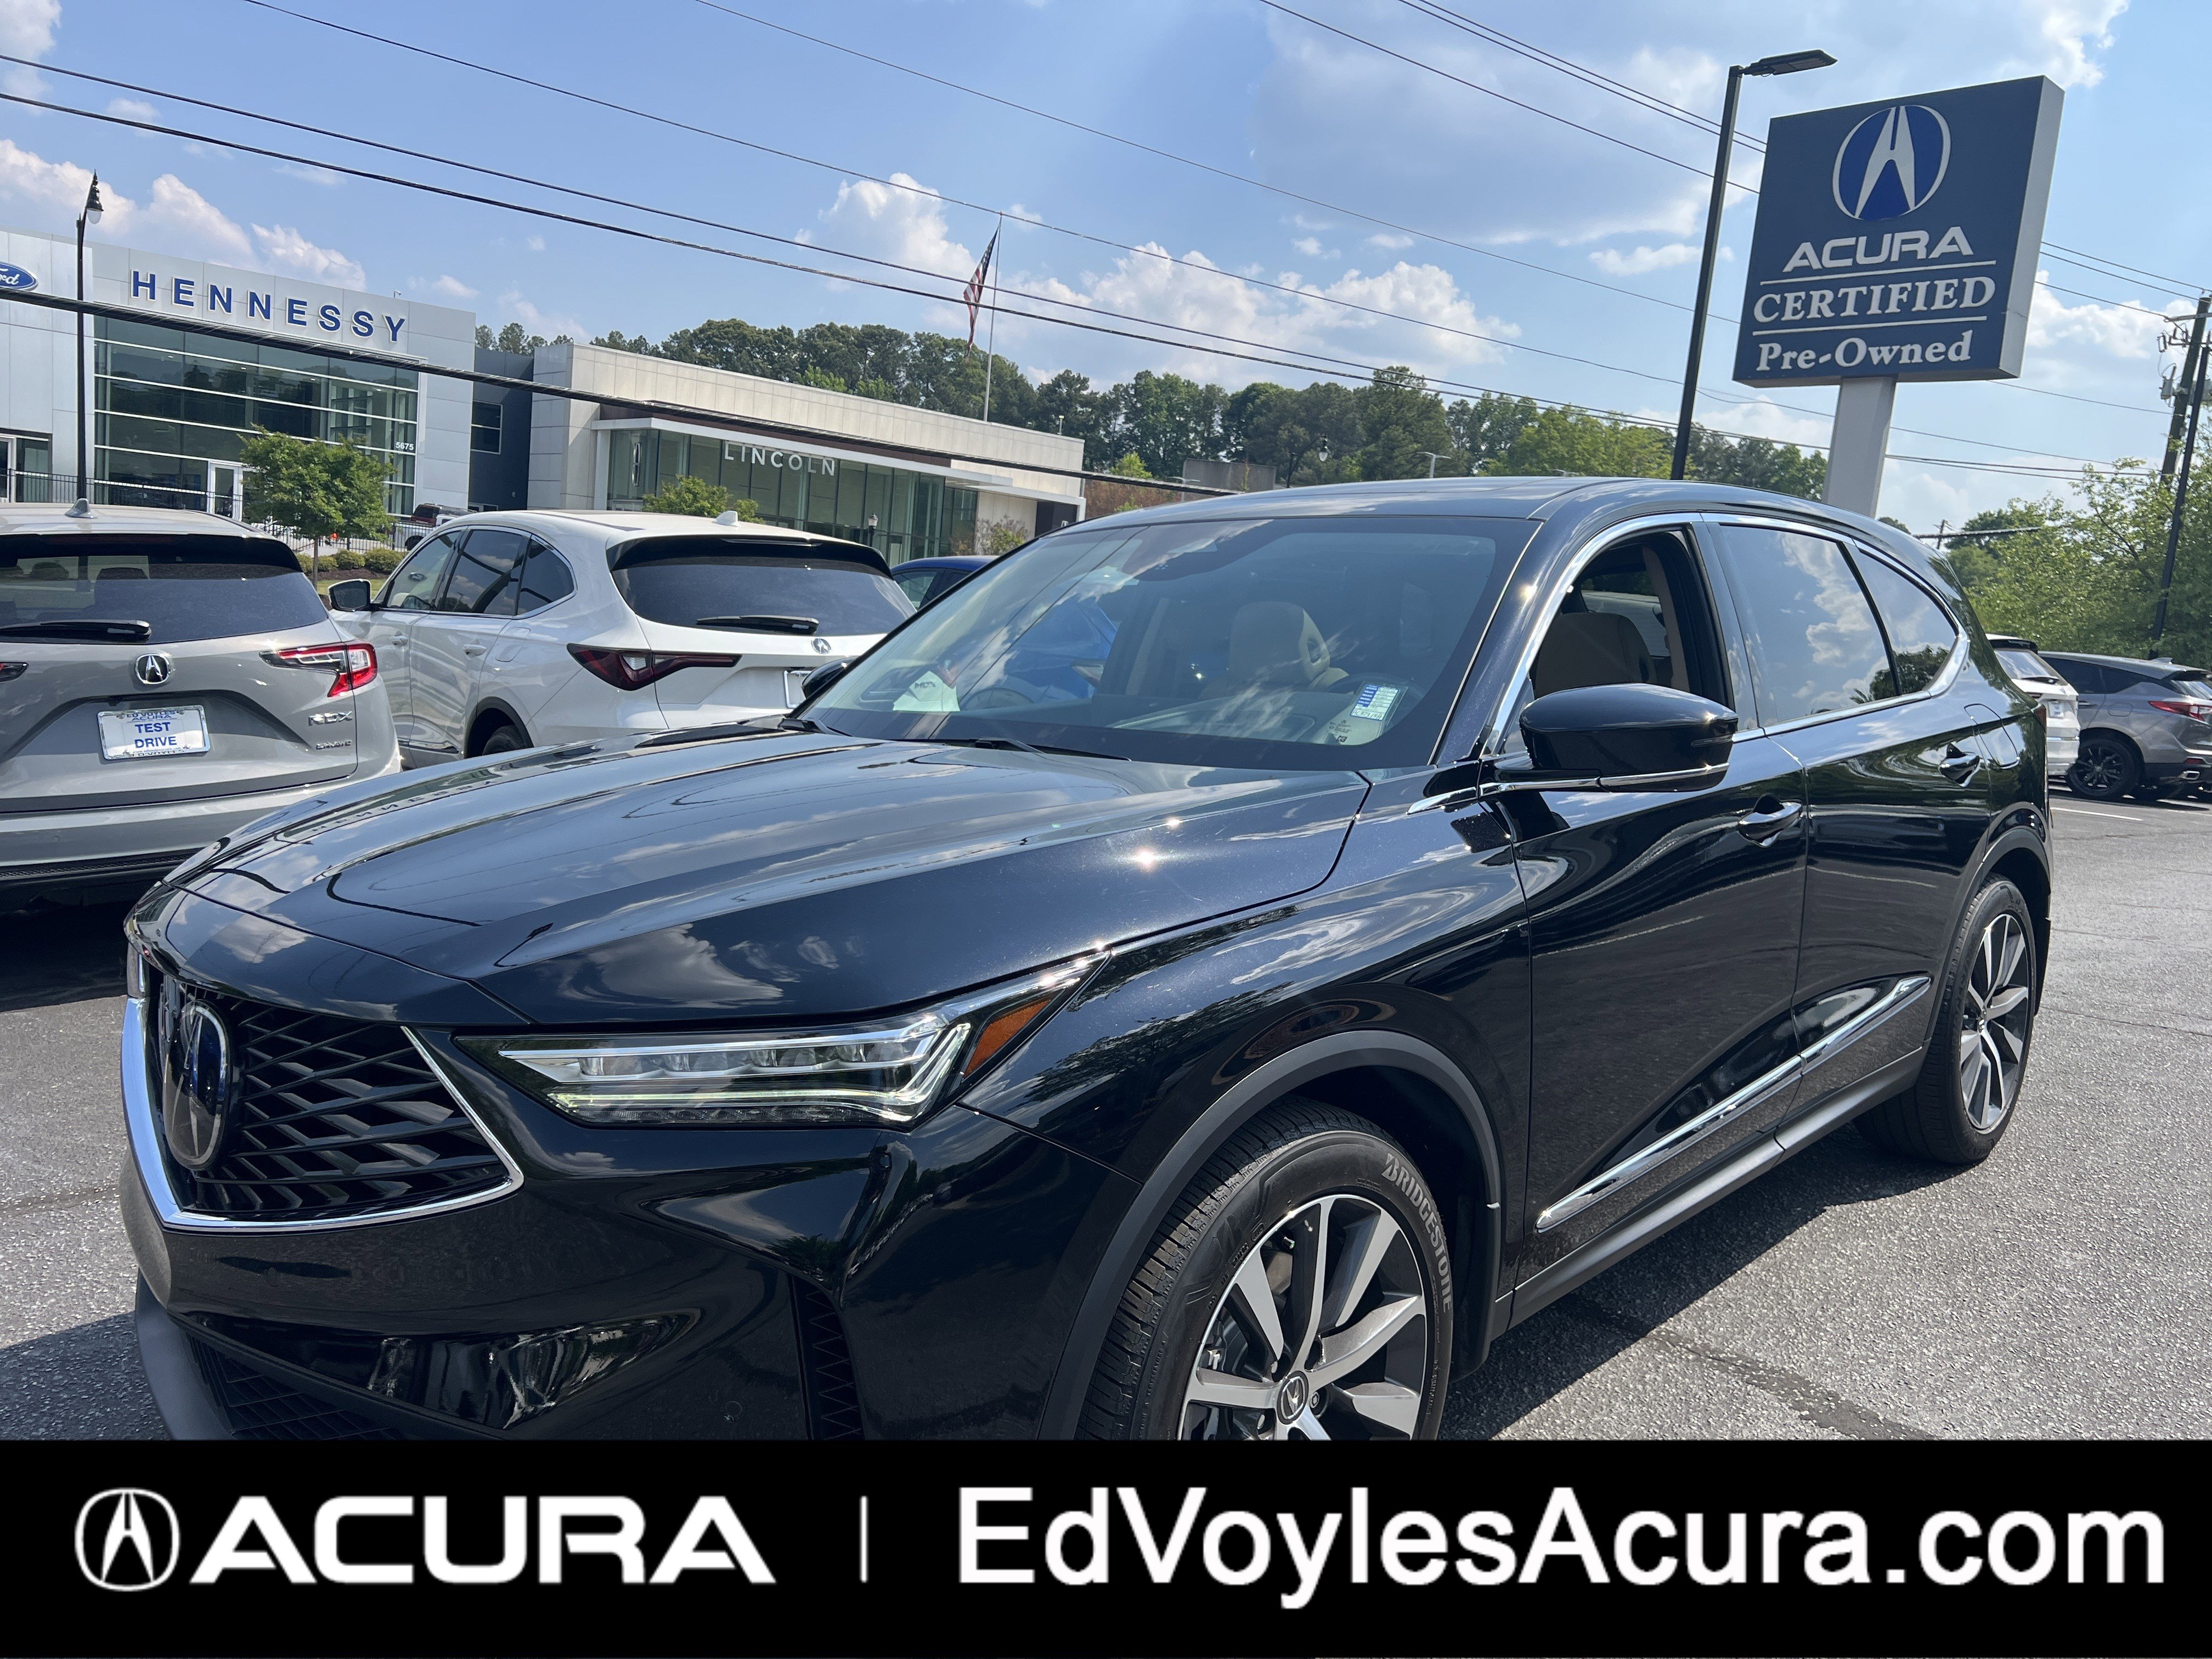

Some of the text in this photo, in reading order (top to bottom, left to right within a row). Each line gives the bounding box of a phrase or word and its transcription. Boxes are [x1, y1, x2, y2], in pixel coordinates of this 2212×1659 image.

[1782, 226, 1974, 273] ACURA
[131, 269, 407, 343] HENNESSY
[1753, 276, 1996, 323] CERTIFIED
[1756, 329, 1973, 372] Pre-Owned
[395, 442, 414, 450] 5675
[724, 441, 835, 476] LINCOLN
[134, 722, 171, 733] TEST
[134, 736, 177, 748] DRIVE
[1381, 1153, 1452, 1313] BRIDGESTONE
